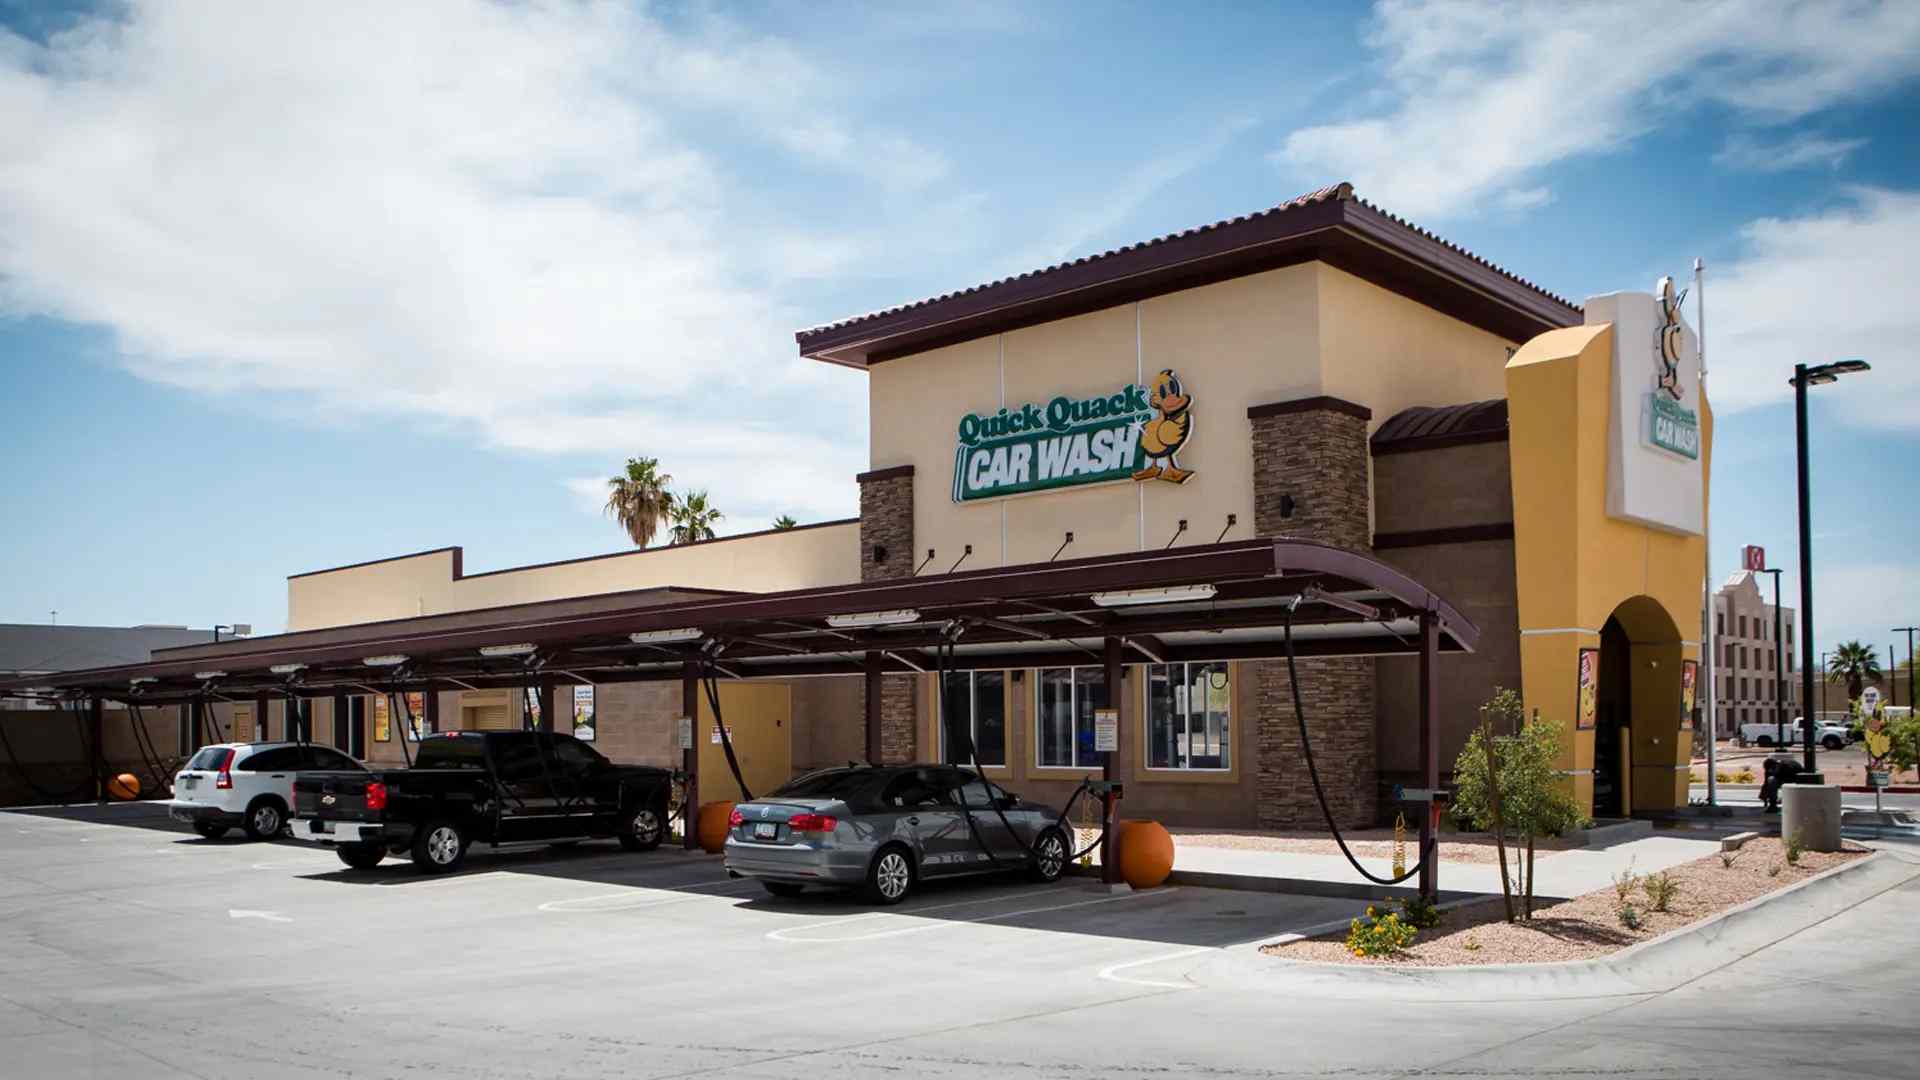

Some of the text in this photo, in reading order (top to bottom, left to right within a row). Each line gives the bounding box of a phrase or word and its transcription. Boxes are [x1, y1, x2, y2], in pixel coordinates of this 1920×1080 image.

[959, 384, 1149, 445] Quick Quack
[968, 427, 1136, 490] CAR WASH
